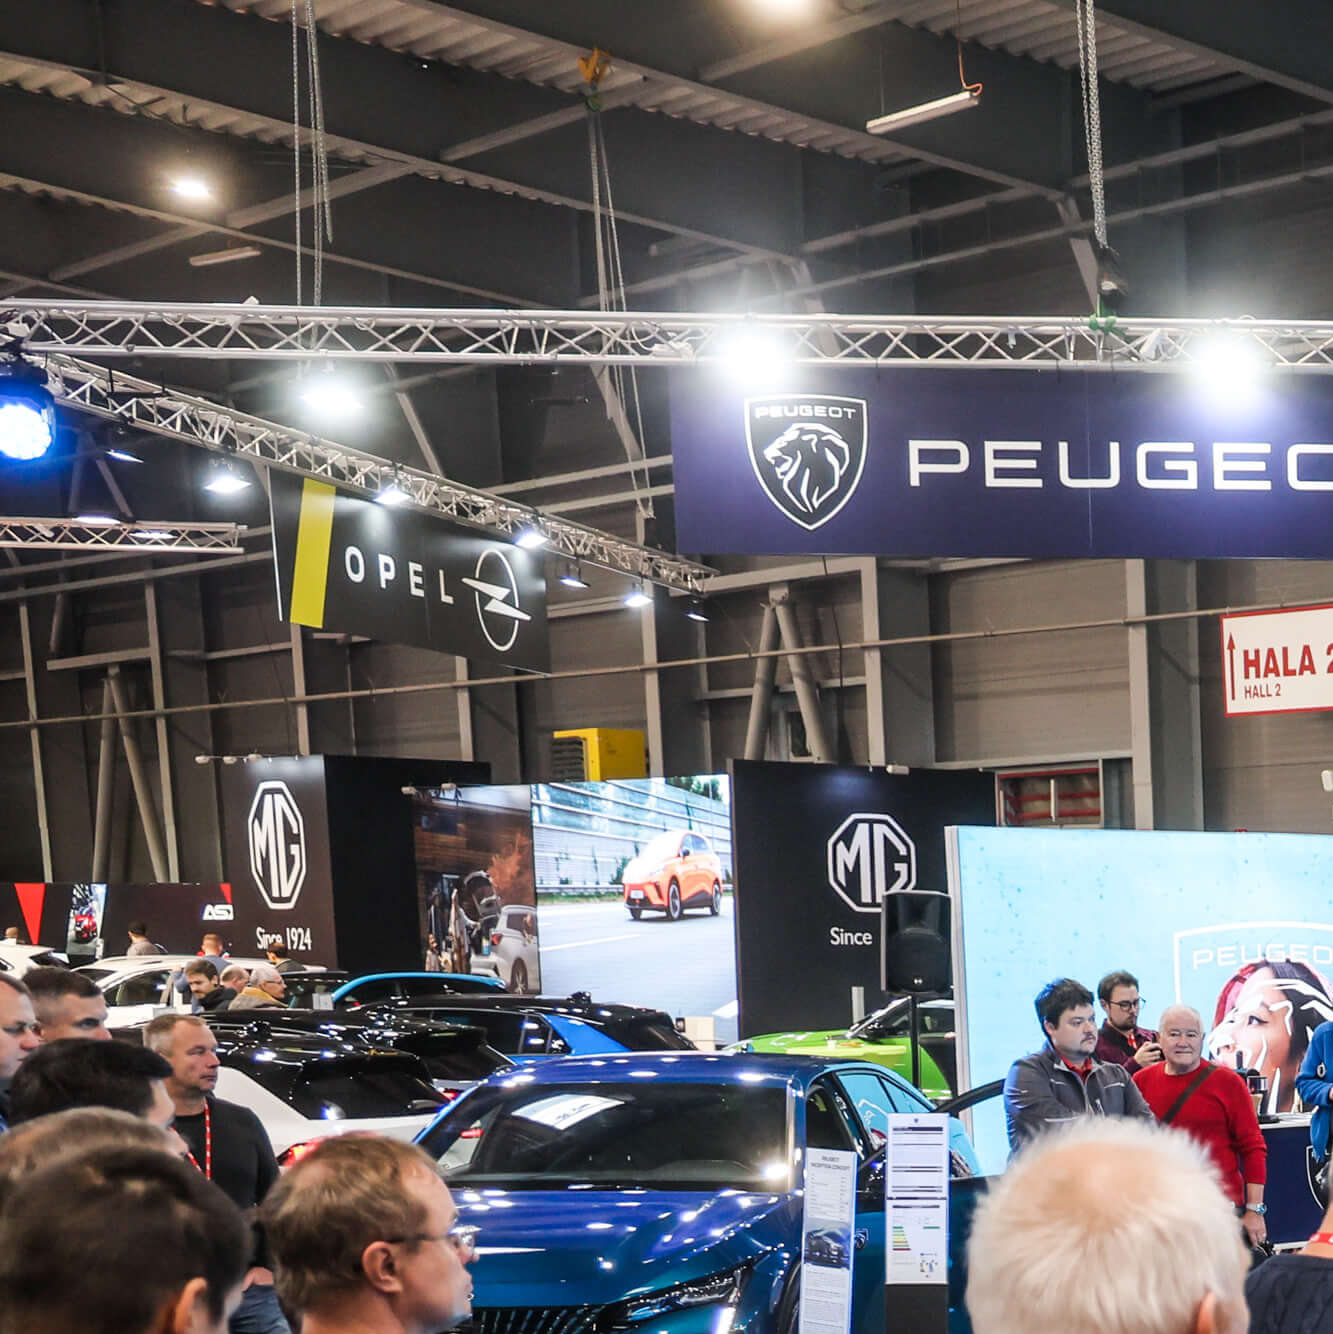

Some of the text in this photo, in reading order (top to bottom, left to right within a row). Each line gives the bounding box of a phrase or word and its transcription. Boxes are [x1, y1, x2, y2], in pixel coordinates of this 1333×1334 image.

[754, 405, 857, 419] PEUGEOT
[344, 545, 455, 605] OPEL
[1243, 644, 1317, 680] HALA
[1244, 683, 1282, 699] HALL 2
[252, 793, 302, 898] MG
[835, 822, 908, 904] MG
[286, 927, 313, 951] 1924
[829, 926, 873, 946] Since
